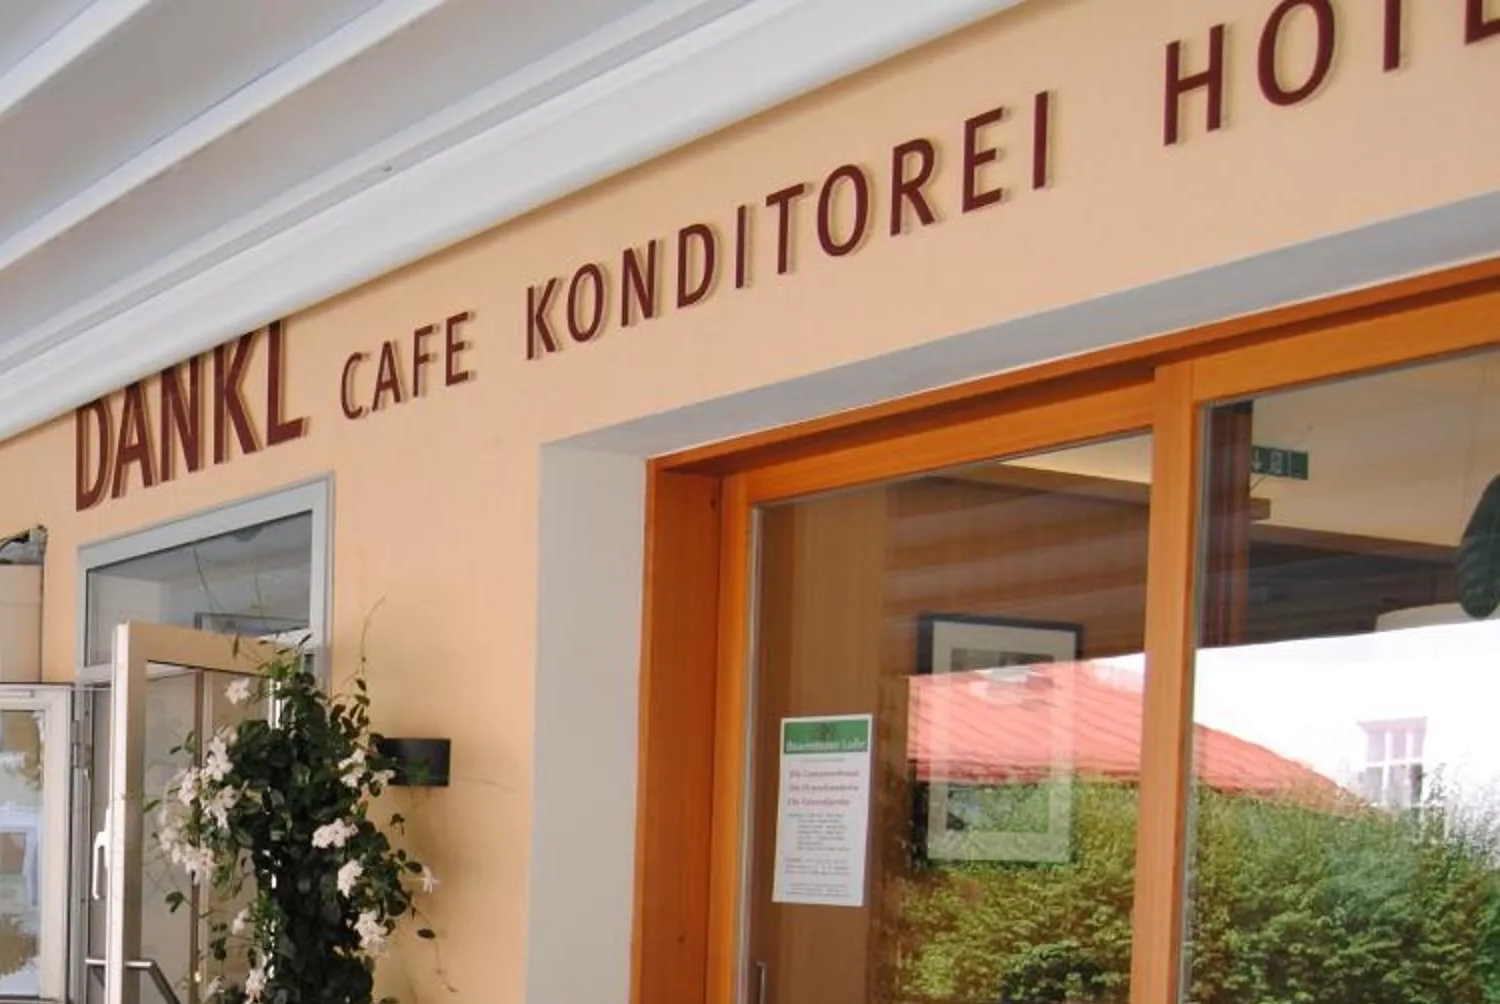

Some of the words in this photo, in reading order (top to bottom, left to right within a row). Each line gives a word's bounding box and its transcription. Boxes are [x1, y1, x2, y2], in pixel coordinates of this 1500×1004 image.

[75, 320, 306, 512] DANKL
[340, 312, 472, 420] CAFE
[526, 90, 1050, 361] KONDITOREI
